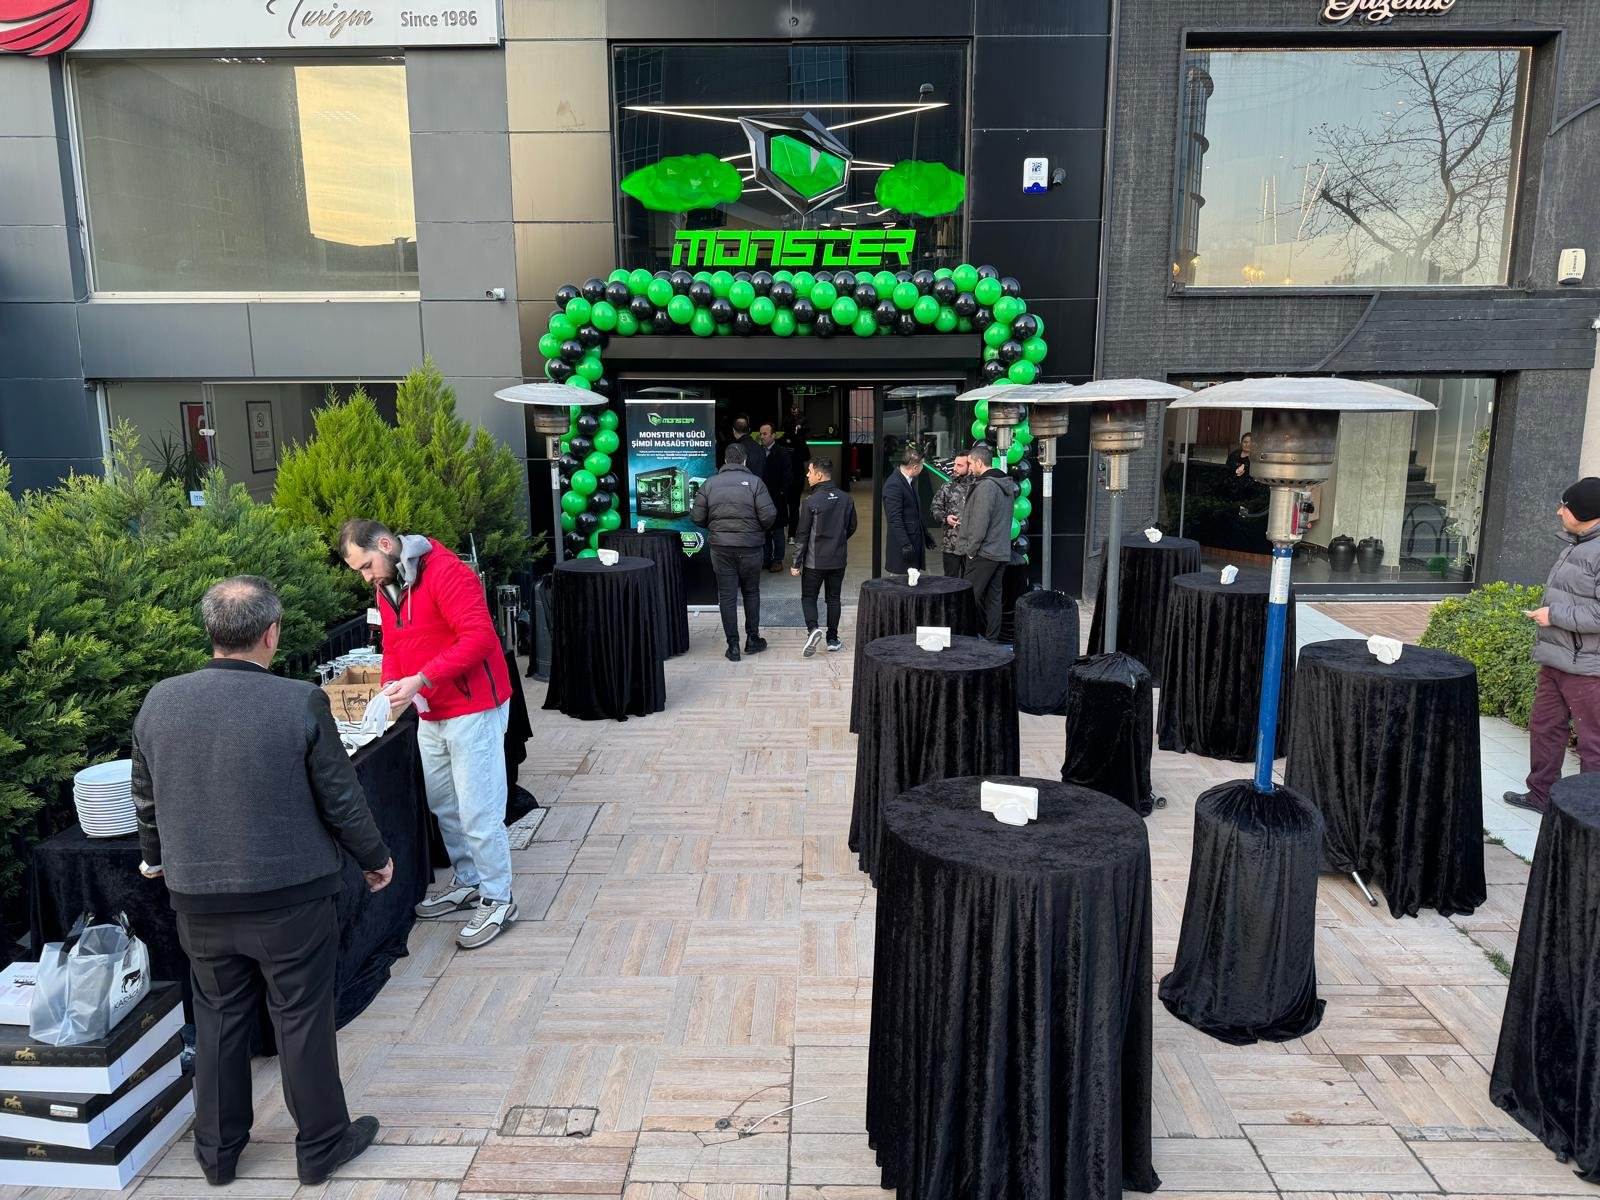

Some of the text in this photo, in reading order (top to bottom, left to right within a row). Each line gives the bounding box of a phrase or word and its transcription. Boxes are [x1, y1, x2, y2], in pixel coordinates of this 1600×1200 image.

[400, 10, 478, 27] Since 1986
[672, 229, 916, 267] MONSTER
[639, 430, 706, 439] MONSTER'IN GÜCÜ
[631, 439, 712, 448] ŞİMDİ MASAÜSTÜNDE!
